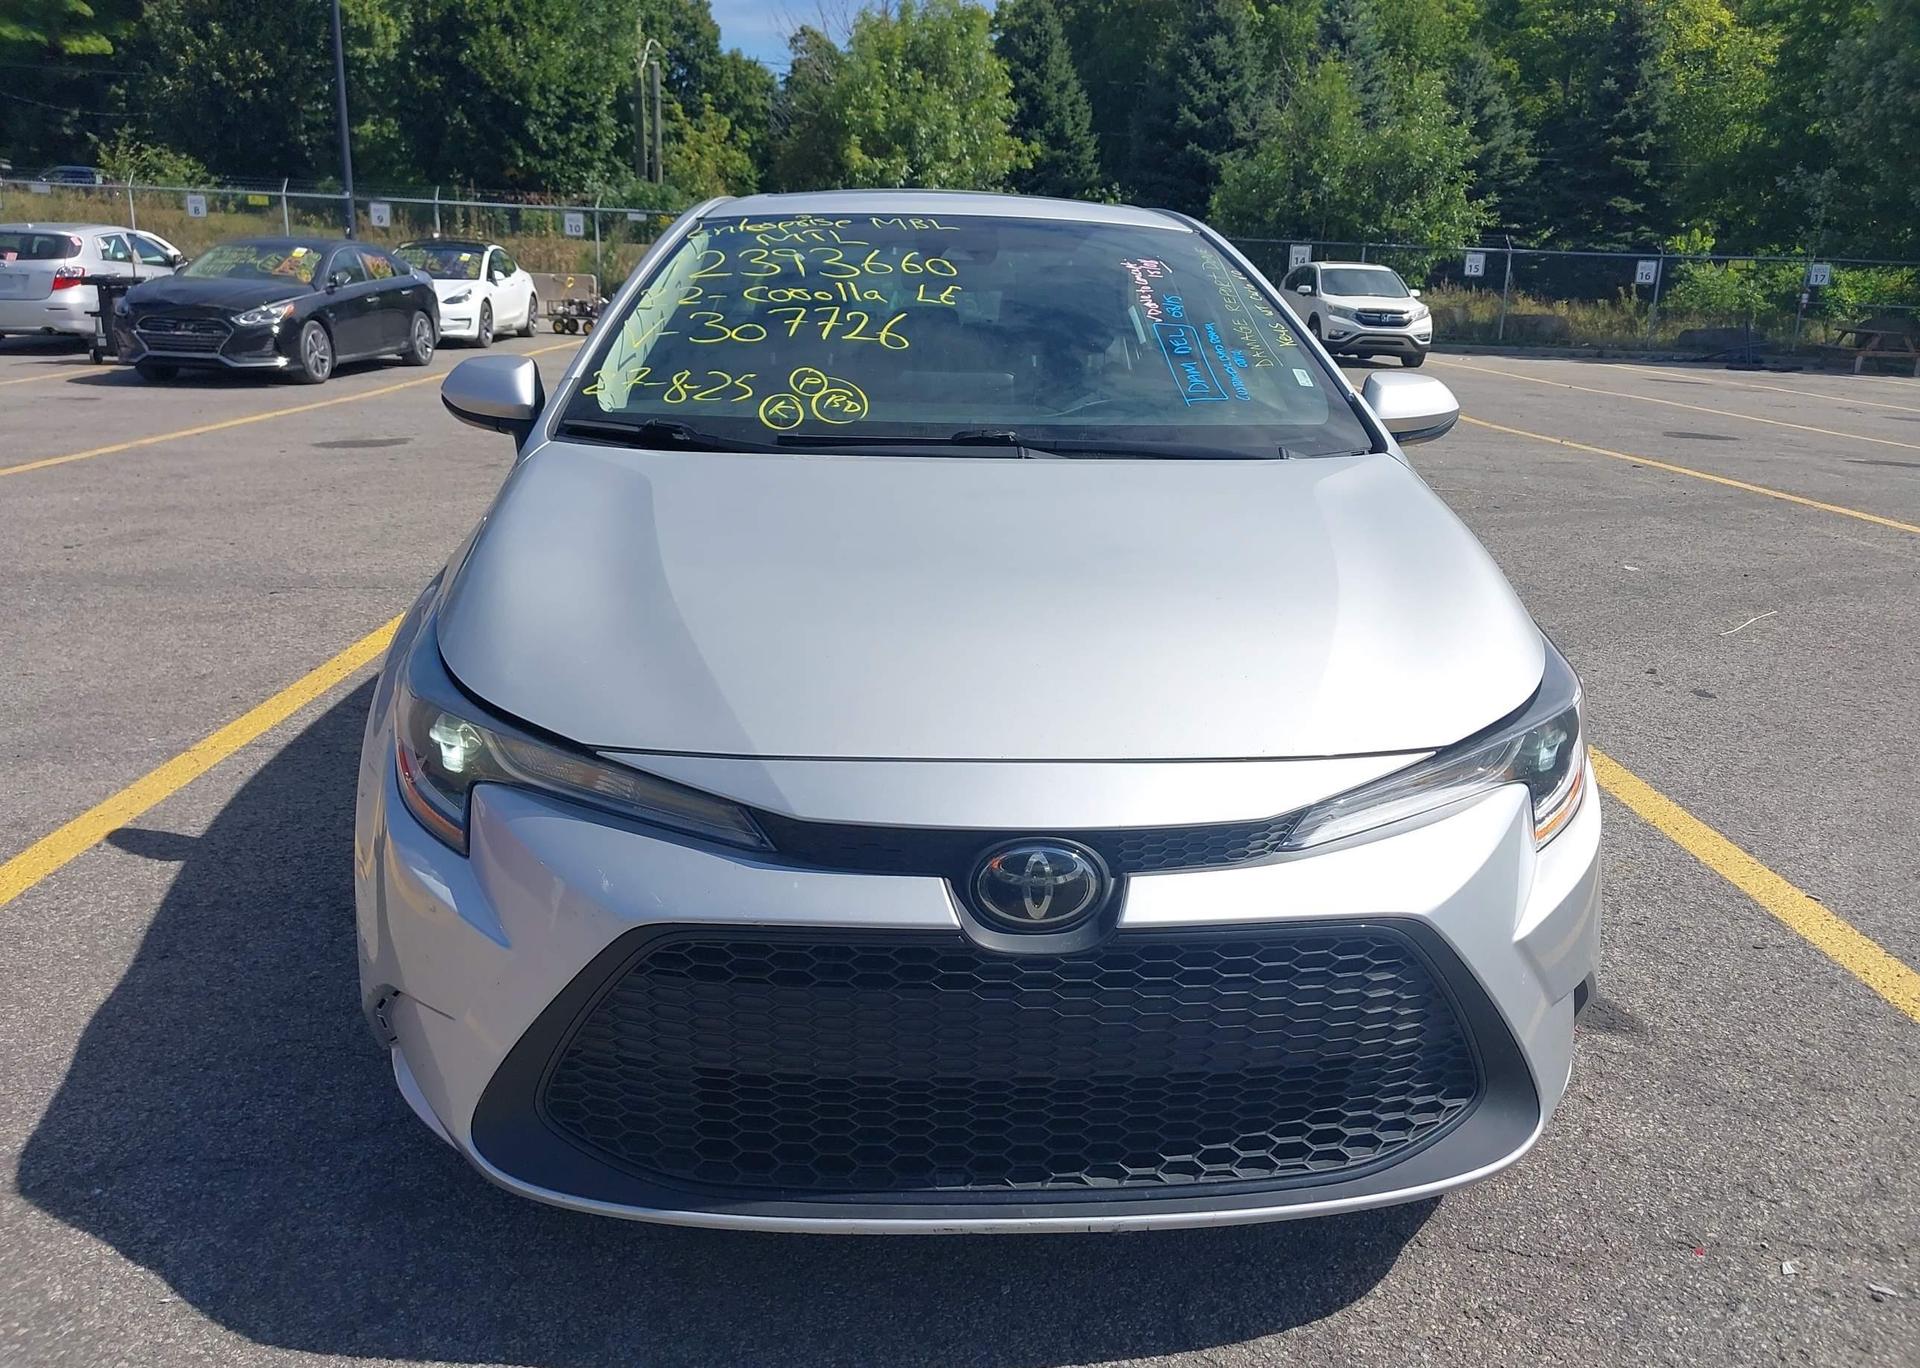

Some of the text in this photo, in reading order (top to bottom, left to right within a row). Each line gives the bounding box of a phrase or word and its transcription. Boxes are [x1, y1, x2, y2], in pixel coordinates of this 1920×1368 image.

[568, 223, 581, 234] 10
[870, 216, 960, 231] MBL
[756, 228, 869, 246] MTL
[688, 247, 958, 279] 2393660
[1294, 255, 1307, 266] 14
[1468, 263, 1480, 274] 15
[1639, 271, 1651, 281] 16
[1814, 273, 1826, 284] 17
[743, 282, 886, 303] Corolla
[917, 283, 962, 306] LE
[1168, 328, 1193, 354] DEL
[1232, 318, 1274, 367] DAMAGE
[824, 393, 861, 413] BD
